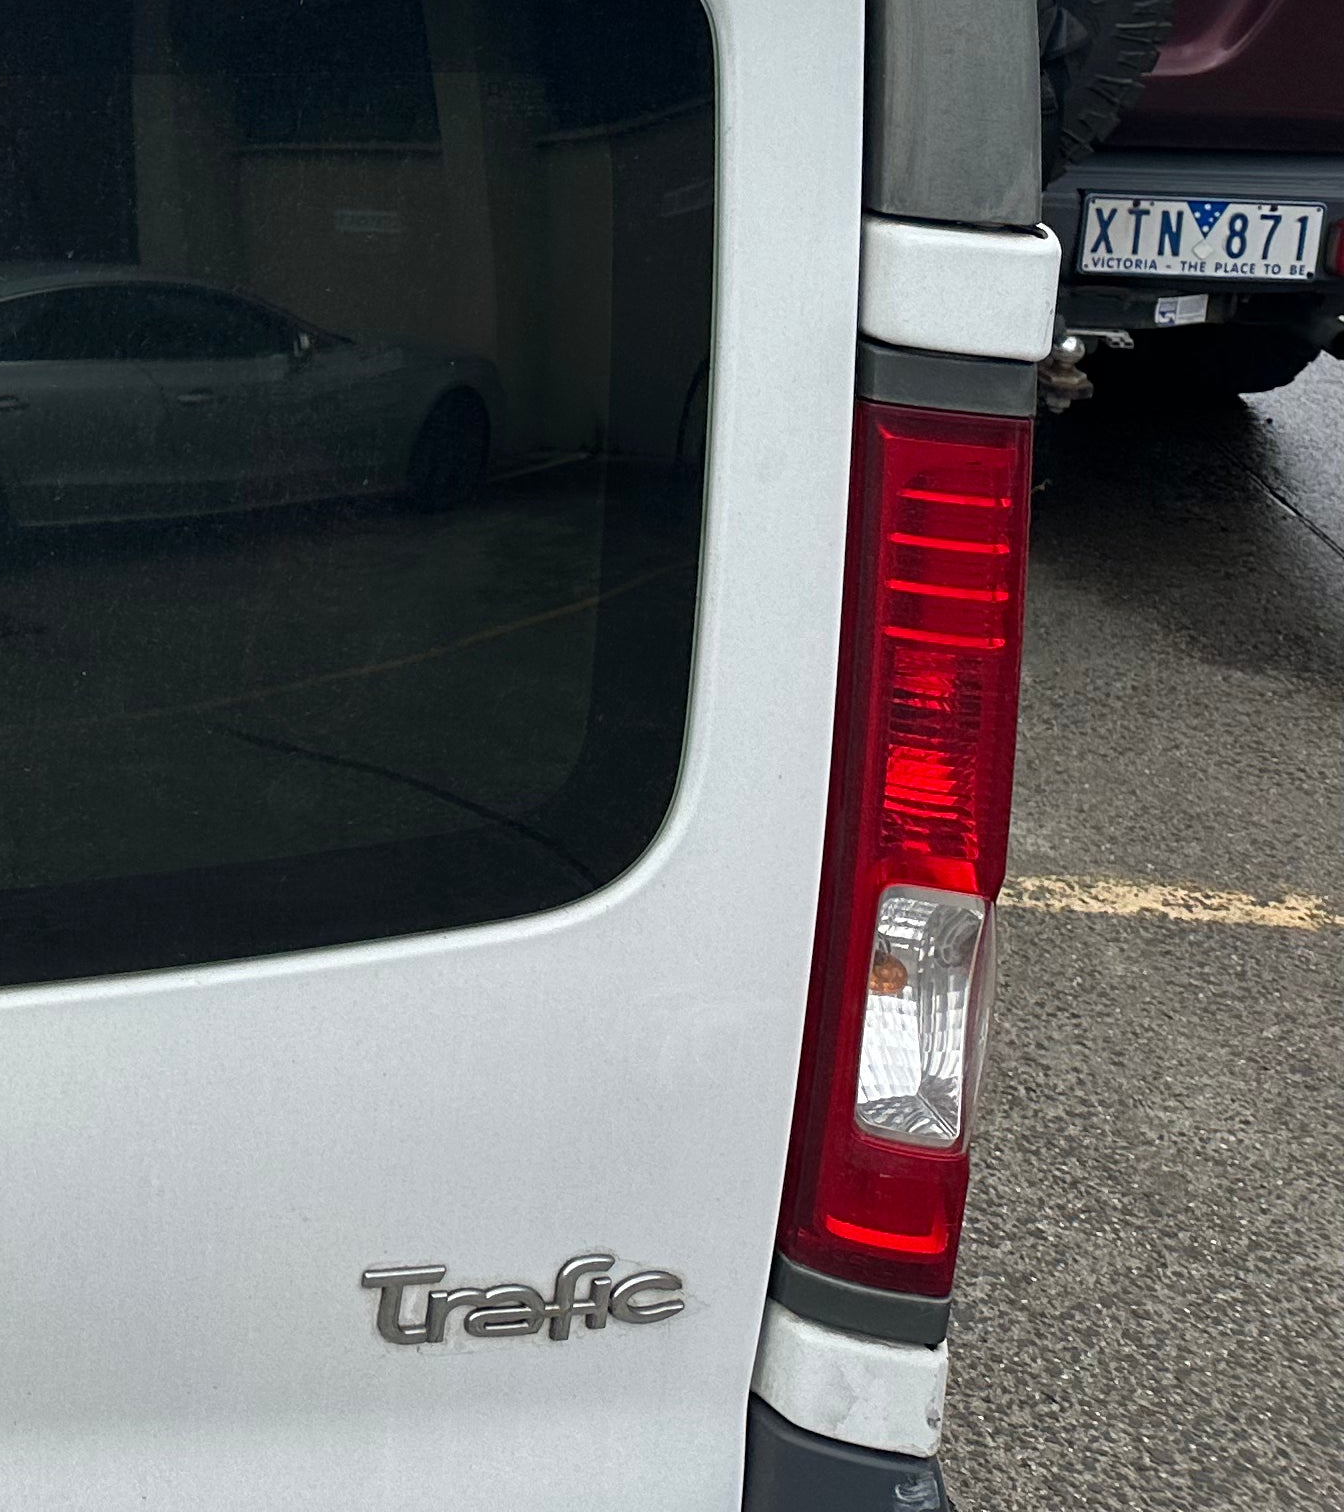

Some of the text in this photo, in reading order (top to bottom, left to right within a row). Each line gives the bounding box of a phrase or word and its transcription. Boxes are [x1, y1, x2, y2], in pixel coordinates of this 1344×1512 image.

[1091, 207, 1308, 261] XTN 871
[1092, 257, 1158, 271] VICTORIA
[1180, 261, 1206, 273] THE
[1215, 262, 1255, 275] PLACE
[1264, 263, 1281, 276] TO
[1290, 264, 1305, 276] BE
[361, 1254, 685, 1345] Trafic
